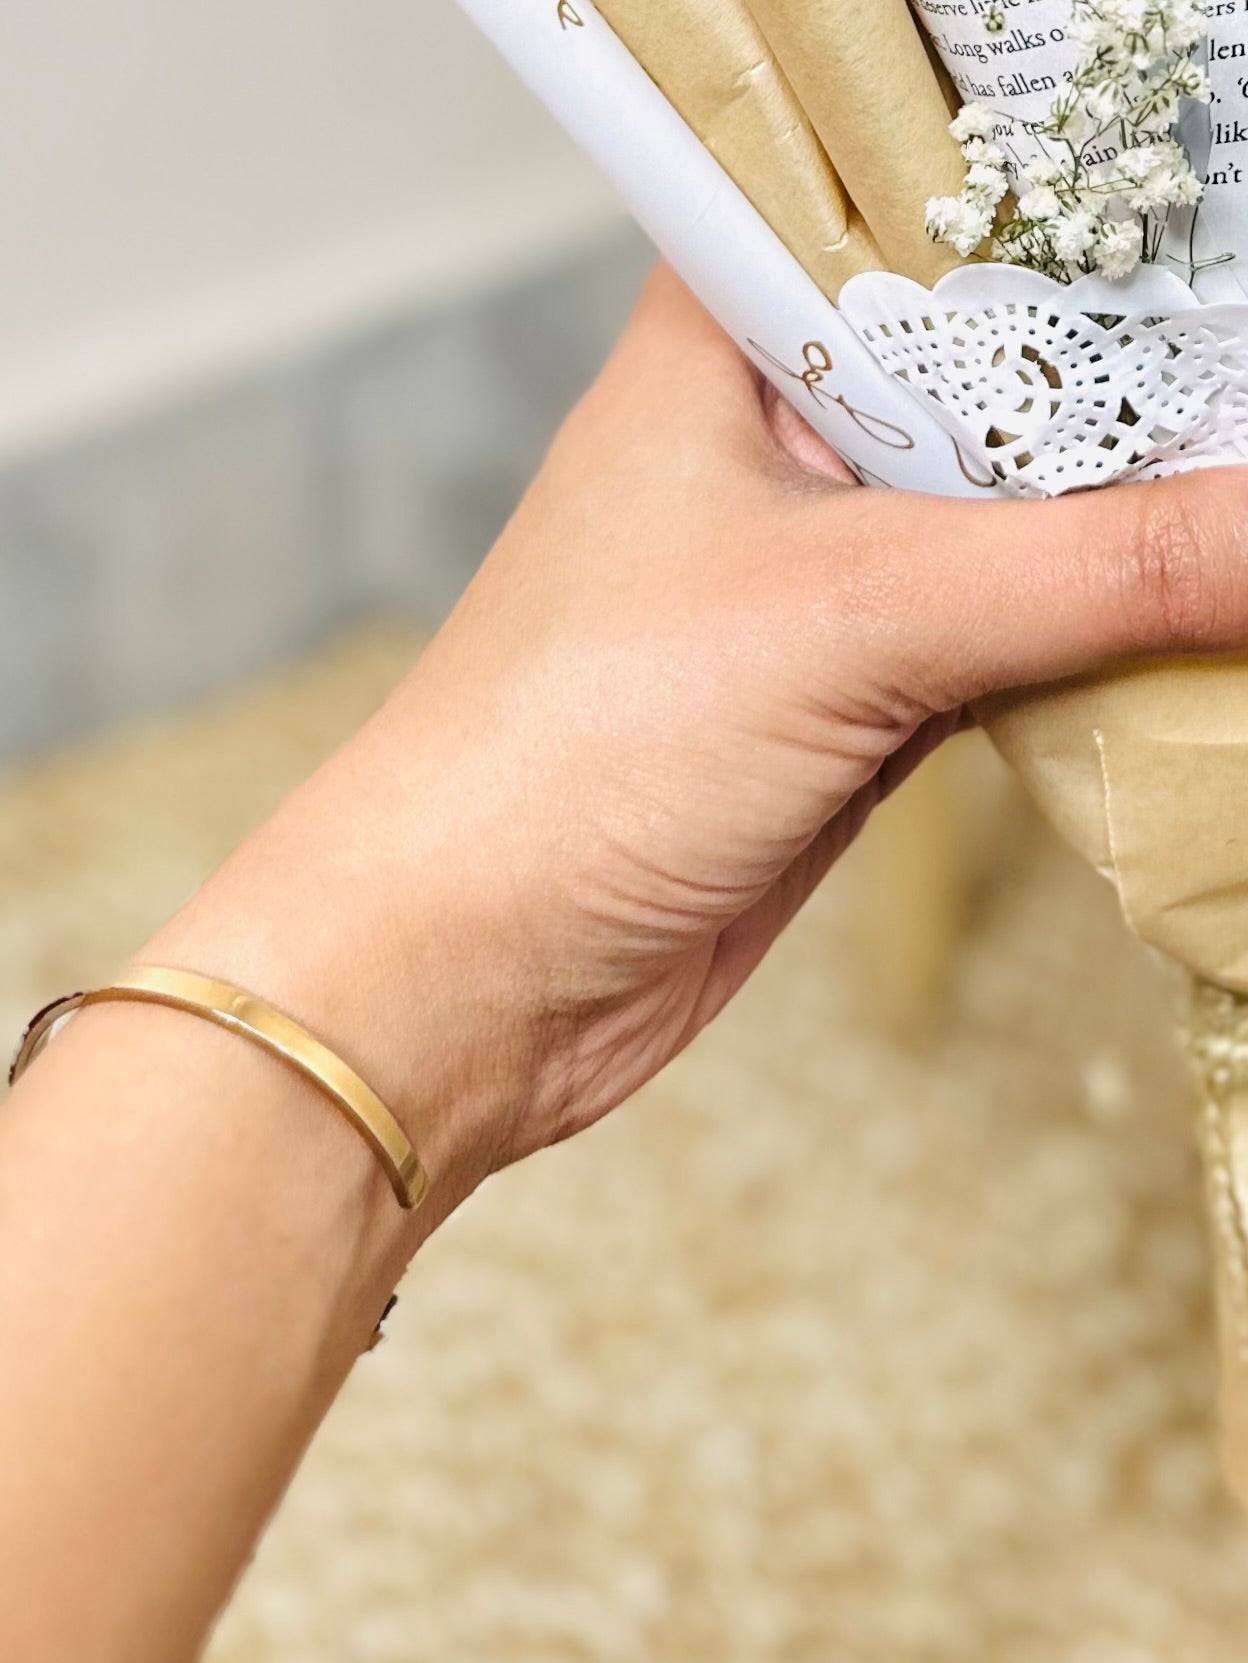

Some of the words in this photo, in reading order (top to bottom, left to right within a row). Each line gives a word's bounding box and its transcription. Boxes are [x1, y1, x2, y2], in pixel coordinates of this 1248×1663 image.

[1204, 1, 1235, 18] ers
[986, 29, 1046, 55] walks
[966, 74, 996, 97] has
[997, 71, 1056, 97] fallen
